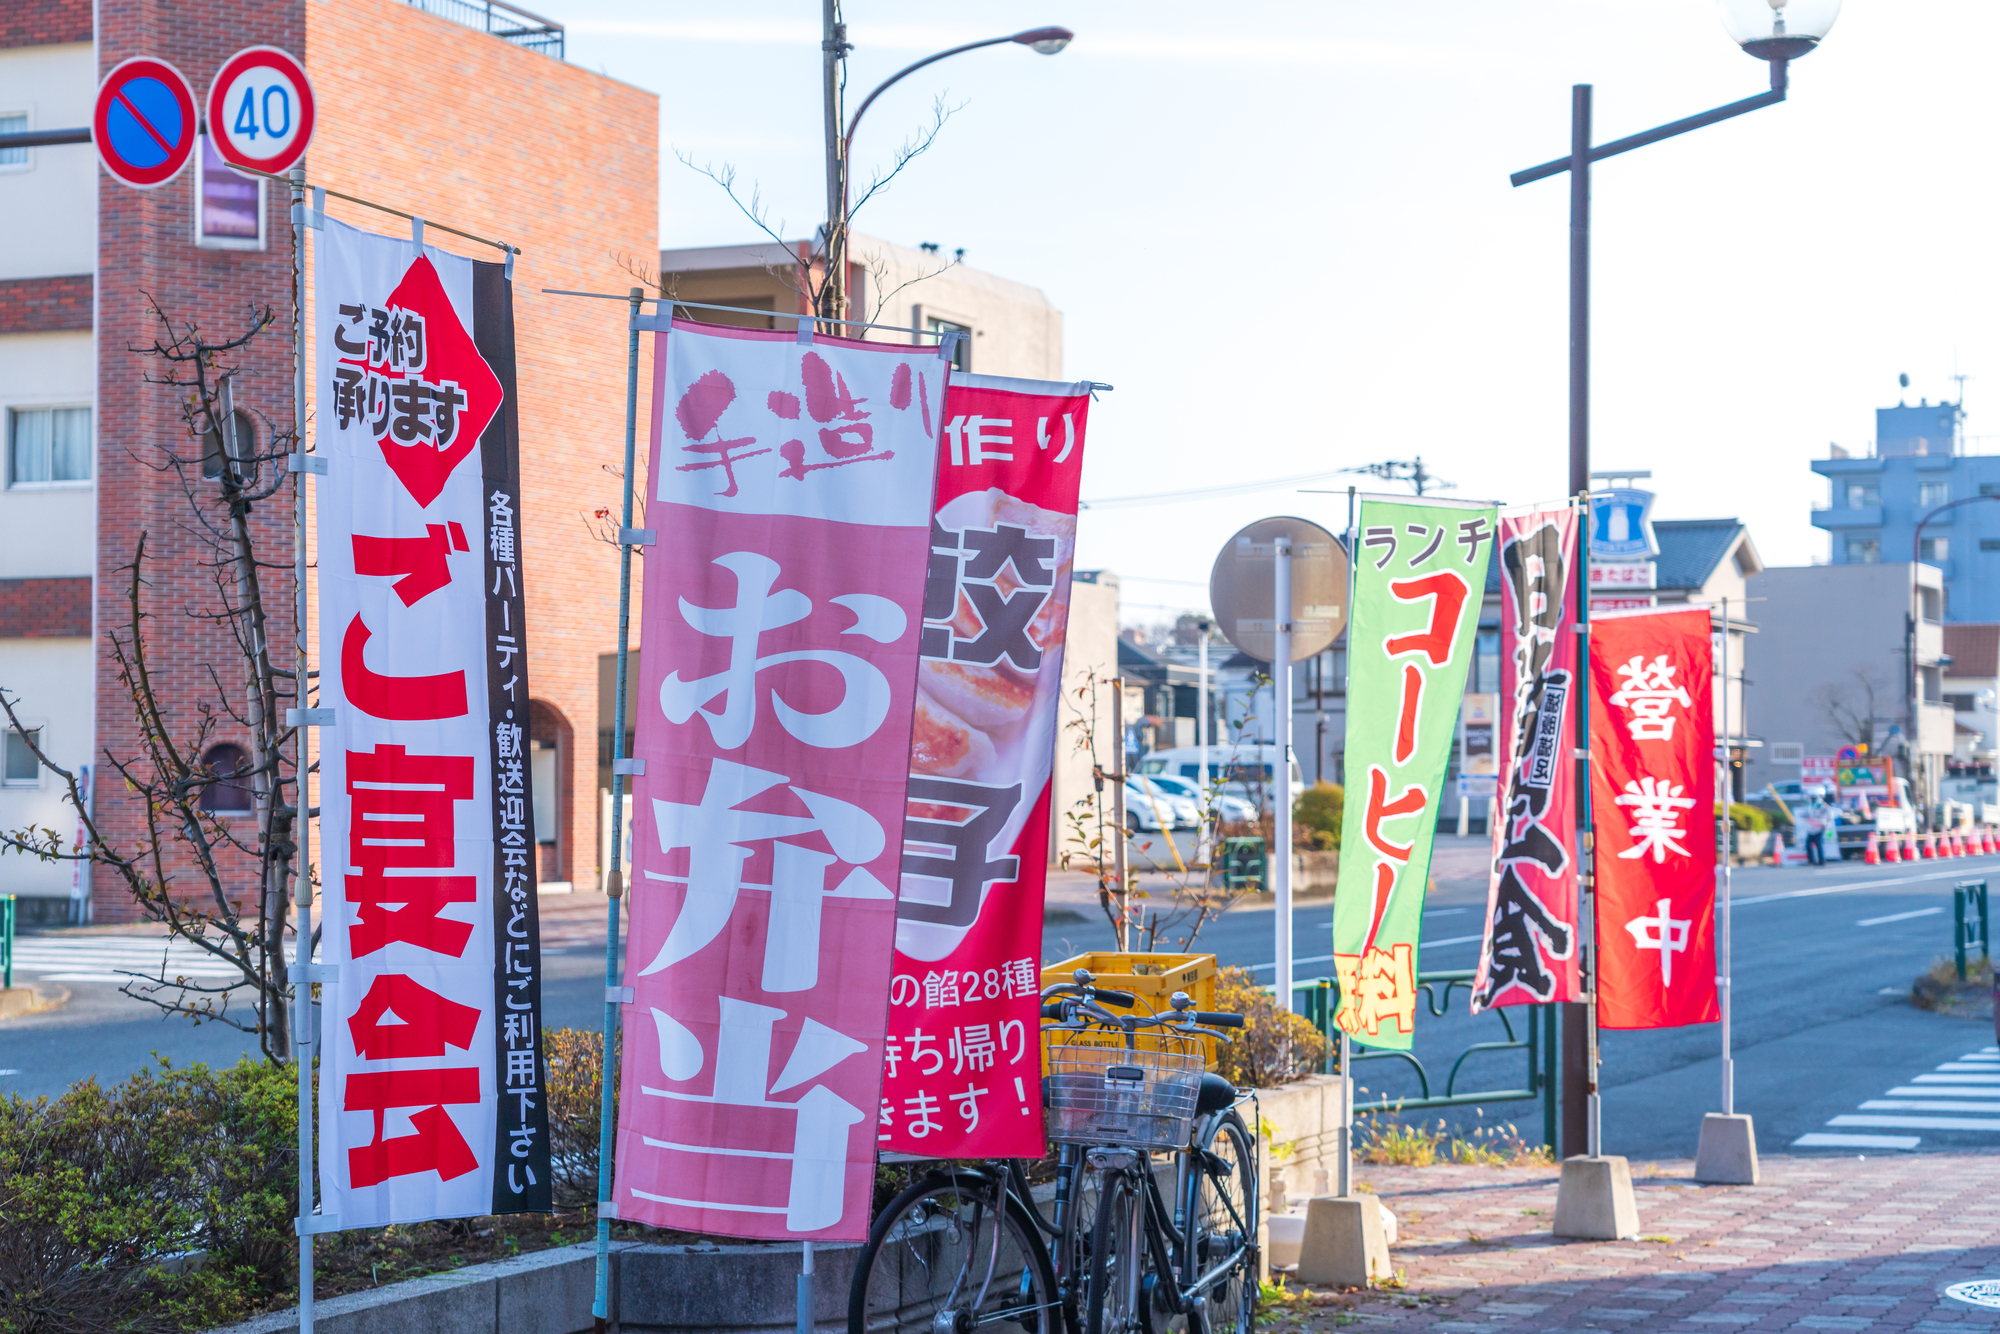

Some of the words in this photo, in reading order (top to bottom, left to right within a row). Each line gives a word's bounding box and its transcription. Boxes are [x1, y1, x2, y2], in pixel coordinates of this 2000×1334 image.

[234, 84, 290, 140] 40
[335, 303, 424, 371] ご予約
[332, 367, 465, 447] 承ります
[675, 351, 933, 497] 手造り
[1364, 518, 1492, 570] ランチ
[1360, 571, 1470, 959] コーヒー
[341, 520, 482, 1189] ご宴会
[631, 551, 908, 1232] お弁当
[891, 957, 1038, 1009] の餡28種
